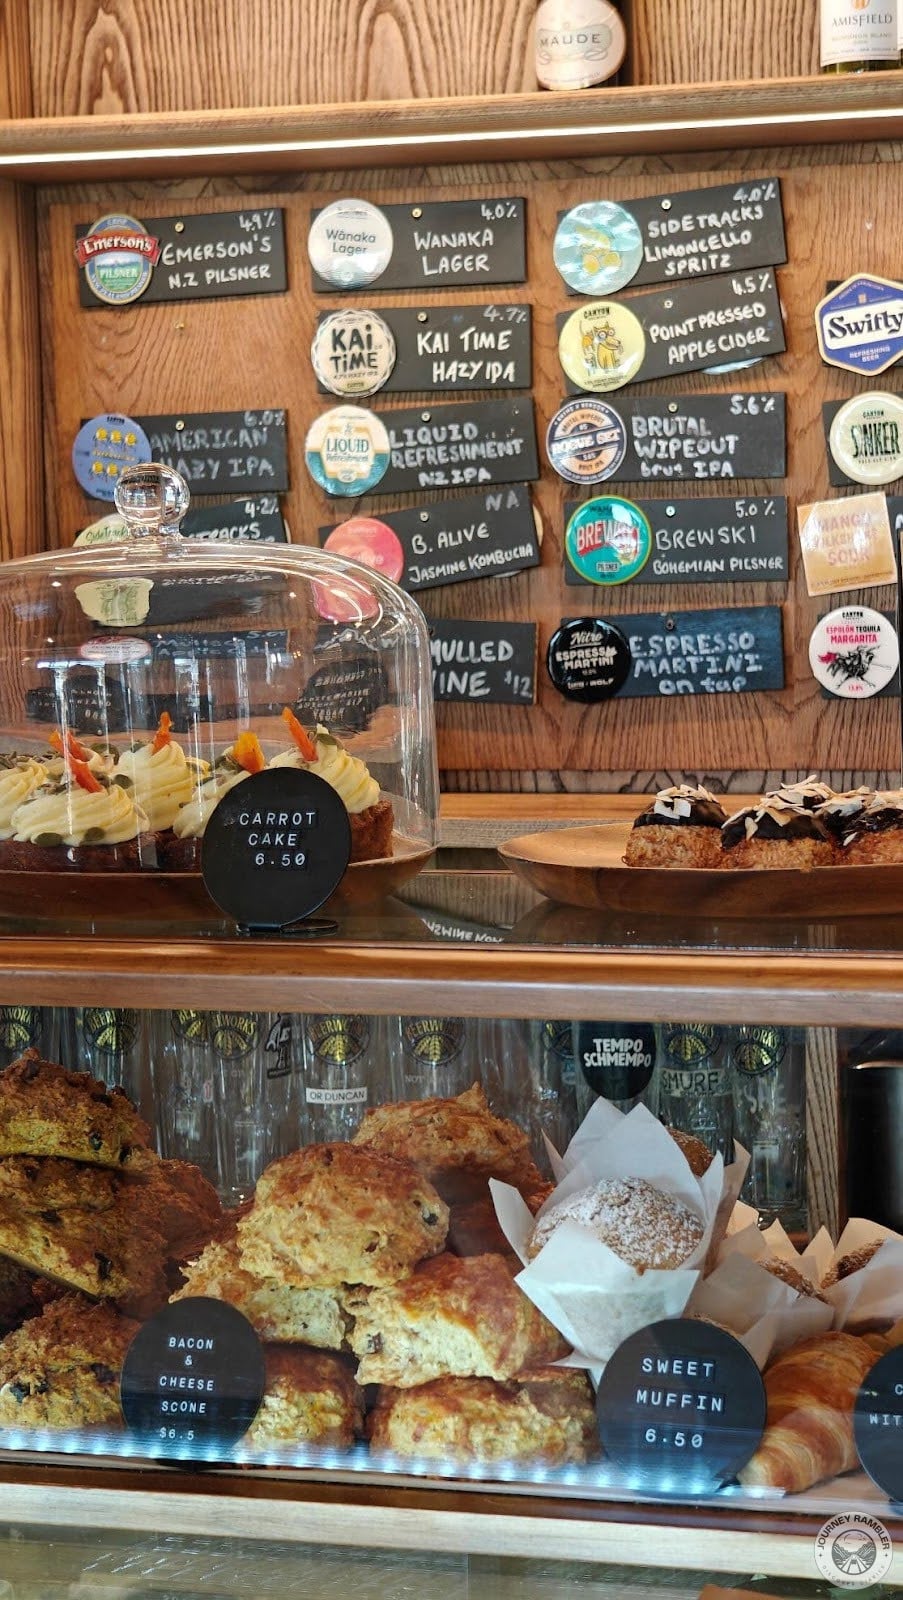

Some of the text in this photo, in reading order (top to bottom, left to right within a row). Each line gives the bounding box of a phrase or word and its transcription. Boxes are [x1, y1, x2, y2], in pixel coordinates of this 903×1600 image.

[832, 14, 892, 27] AMISFIELD
[540, 33, 601, 48] MAUDE
[239, 211, 276, 232] 4.9%
[481, 202, 517, 221] 4.0%
[333, 242, 367, 257] Lager
[414, 228, 494, 251] WANAKA
[644, 230, 752, 263] LIMONCELLO
[161, 234, 272, 266] EMERSON'S
[100, 267, 138, 280] PILSNER
[204, 264, 272, 285] PILSNER
[422, 254, 491, 276] LAGER
[664, 253, 732, 276] SPRITZ
[731, 273, 773, 296] 4.5%
[482, 305, 527, 324] 4.7%
[417, 326, 513, 356] KAI TIME
[433, 360, 516, 384] HAZY IPA
[730, 394, 775, 415] 5.6%
[388, 422, 479, 449] LIQUID
[631, 416, 712, 438] BRUTAL
[391, 438, 524, 470] REFRESHMENT
[634, 434, 739, 460] WIPEOUT
[227, 456, 275, 478] IPA
[693, 460, 735, 478] IPA
[437, 522, 490, 550] ALIVE
[655, 525, 756, 551] BREWSKI
[652, 556, 784, 576] BOHEMIAN PILSNER
[831, 634, 878, 644] MARGARITA
[856, 625, 881, 633] TEQUILA
[630, 632, 755, 657] ESPRESSO
[563, 656, 614, 671] MARTINI
[634, 653, 762, 678] MARTINI
[504, 670, 532, 699] $12
[659, 677, 693, 695] on
[239, 811, 316, 826] CARROT
[248, 833, 298, 847] CAKE
[255, 853, 306, 867] 6.50
[593, 1037, 644, 1053] TEMPO
[584, 1051, 652, 1068] SCHMEMPO
[309, 1090, 365, 1101] OR DUNCAN
[169, 1337, 214, 1350] BACON
[184, 1355, 193, 1366] &
[642, 1357, 714, 1377] SWEET
[159, 1376, 214, 1391] CHEESE
[161, 1401, 206, 1413] SCONE
[636, 1389, 722, 1412] MUFFIN
[159, 1427, 195, 1441] $6.5
[645, 1428, 703, 1448] 6.50
